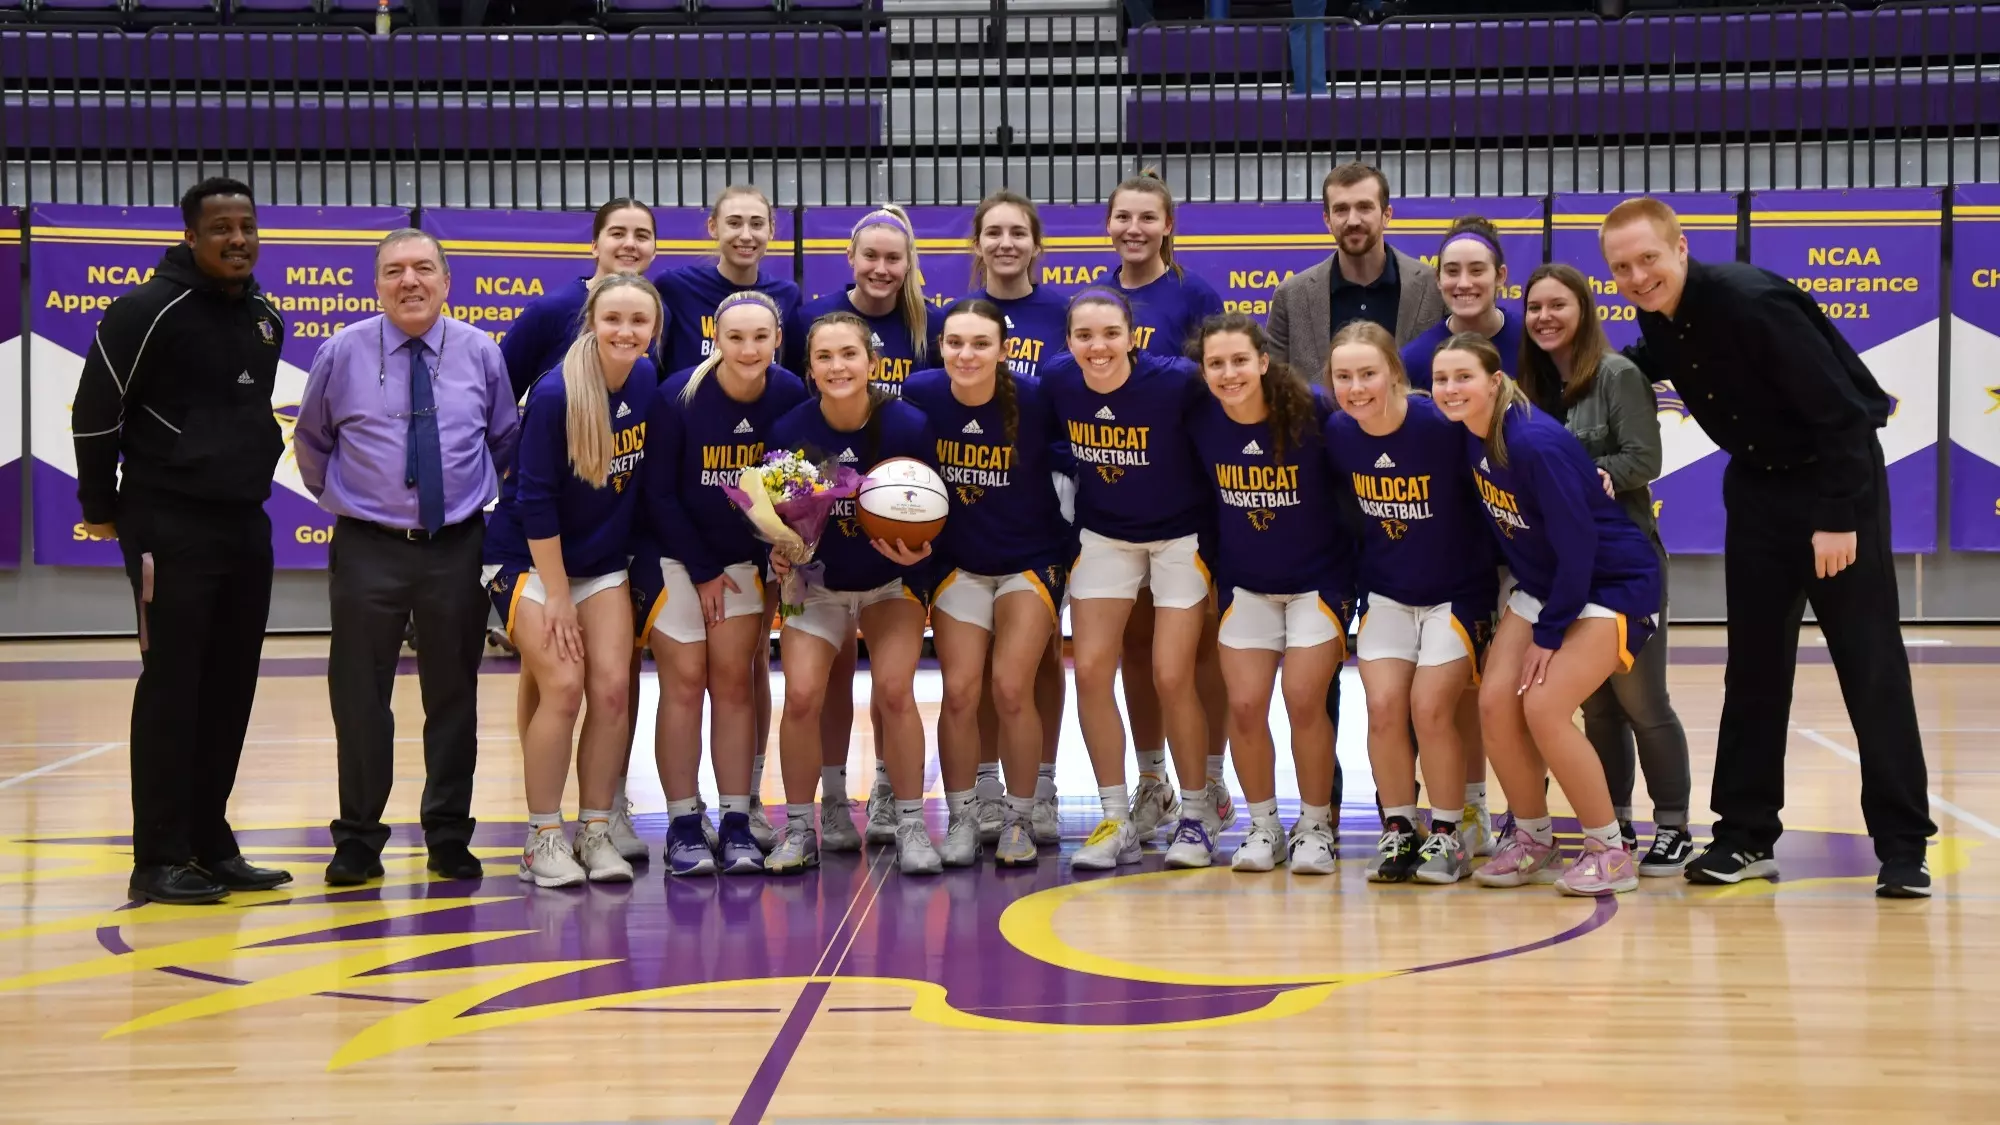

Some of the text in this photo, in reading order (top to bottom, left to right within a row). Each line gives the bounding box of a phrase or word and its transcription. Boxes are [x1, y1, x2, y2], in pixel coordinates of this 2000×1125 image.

[1807, 247, 1881, 266] NCAA
[286, 266, 353, 286] MIAC
[475, 276, 544, 296] NCAA
[1787, 277, 1919, 293] pearance
[265, 292, 385, 316] hampions
[440, 301, 525, 325] Appear
[1596, 305, 1637, 321] 020
[1067, 419, 1150, 450] WILDCAT
[1070, 442, 1151, 466] BASKETBALL
[940, 465, 1011, 487] ASKETBALL
[1215, 463, 1299, 491] WILDCAT
[1352, 471, 1431, 502] WILDCAT
[1220, 488, 1301, 508] BASKETBALL
[1357, 496, 1434, 520] BASKETBALL
[295, 525, 334, 544] Gol
